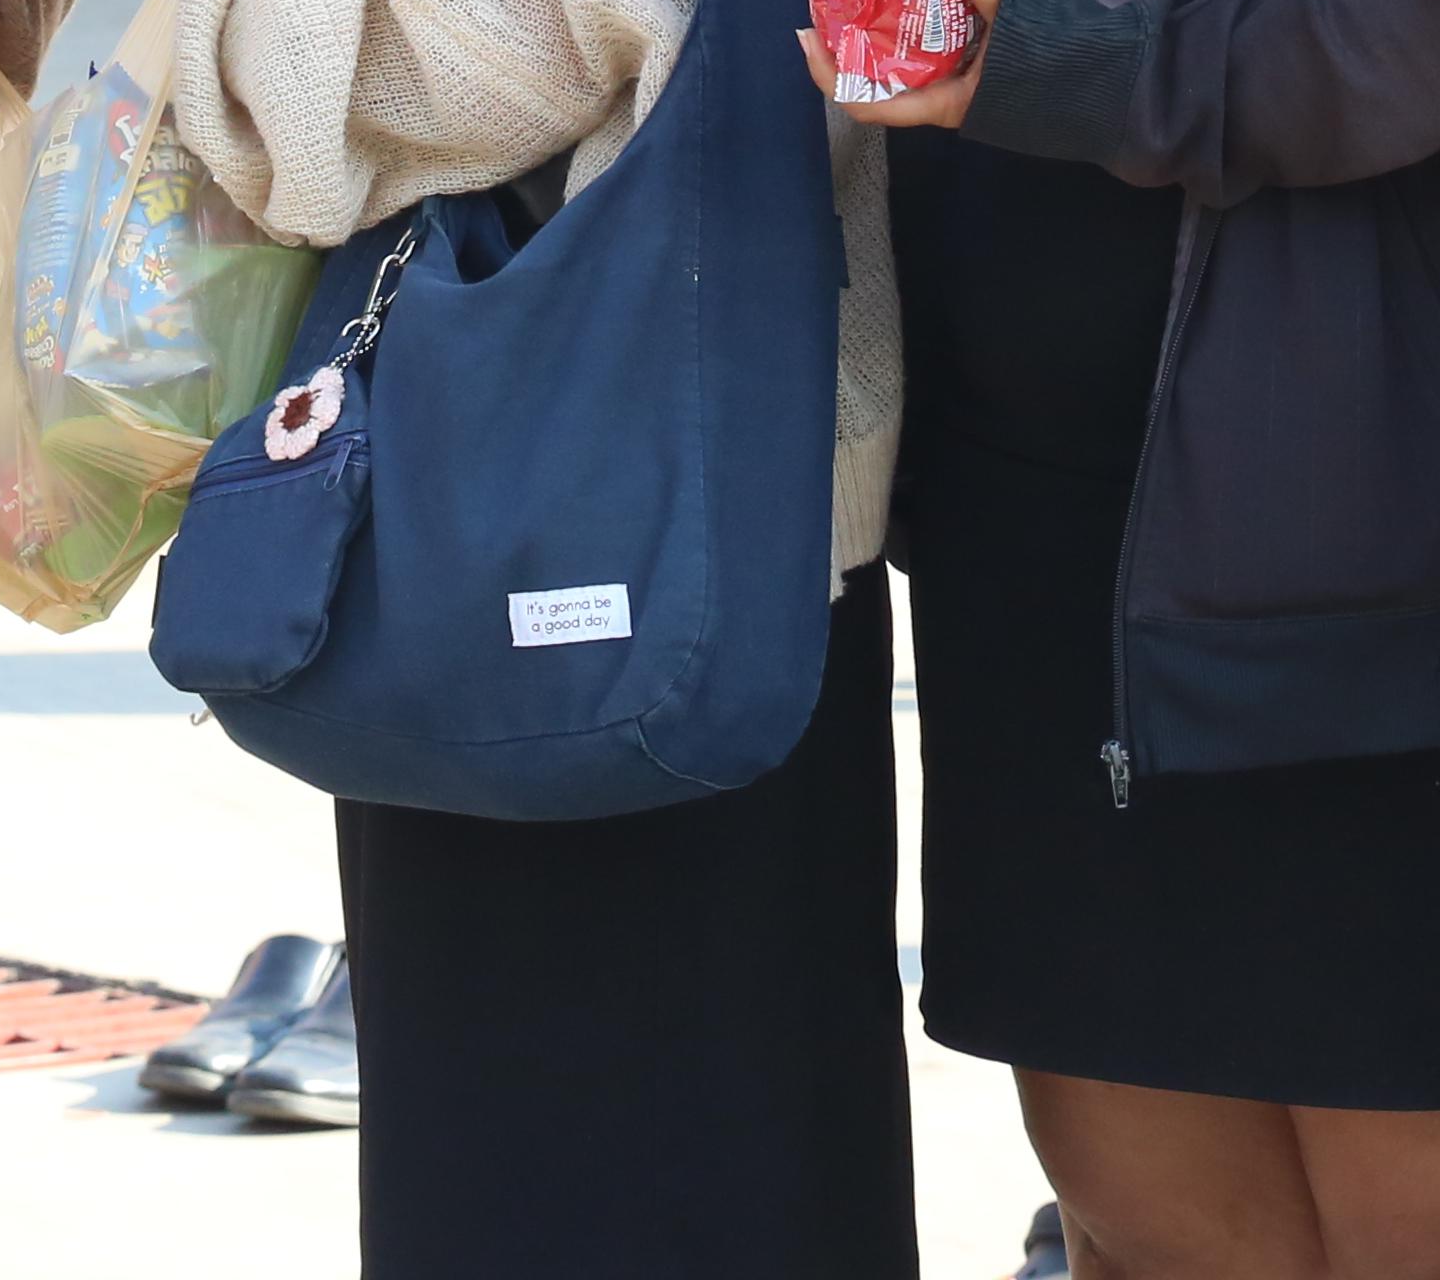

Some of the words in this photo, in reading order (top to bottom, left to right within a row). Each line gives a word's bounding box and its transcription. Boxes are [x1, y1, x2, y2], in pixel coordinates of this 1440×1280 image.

[526, 602, 544, 615] It's
[548, 601, 591, 617] gonna
[594, 596, 612, 609] be
[531, 623, 541, 632] a
[544, 616, 580, 634] good
[584, 614, 610, 629] day
